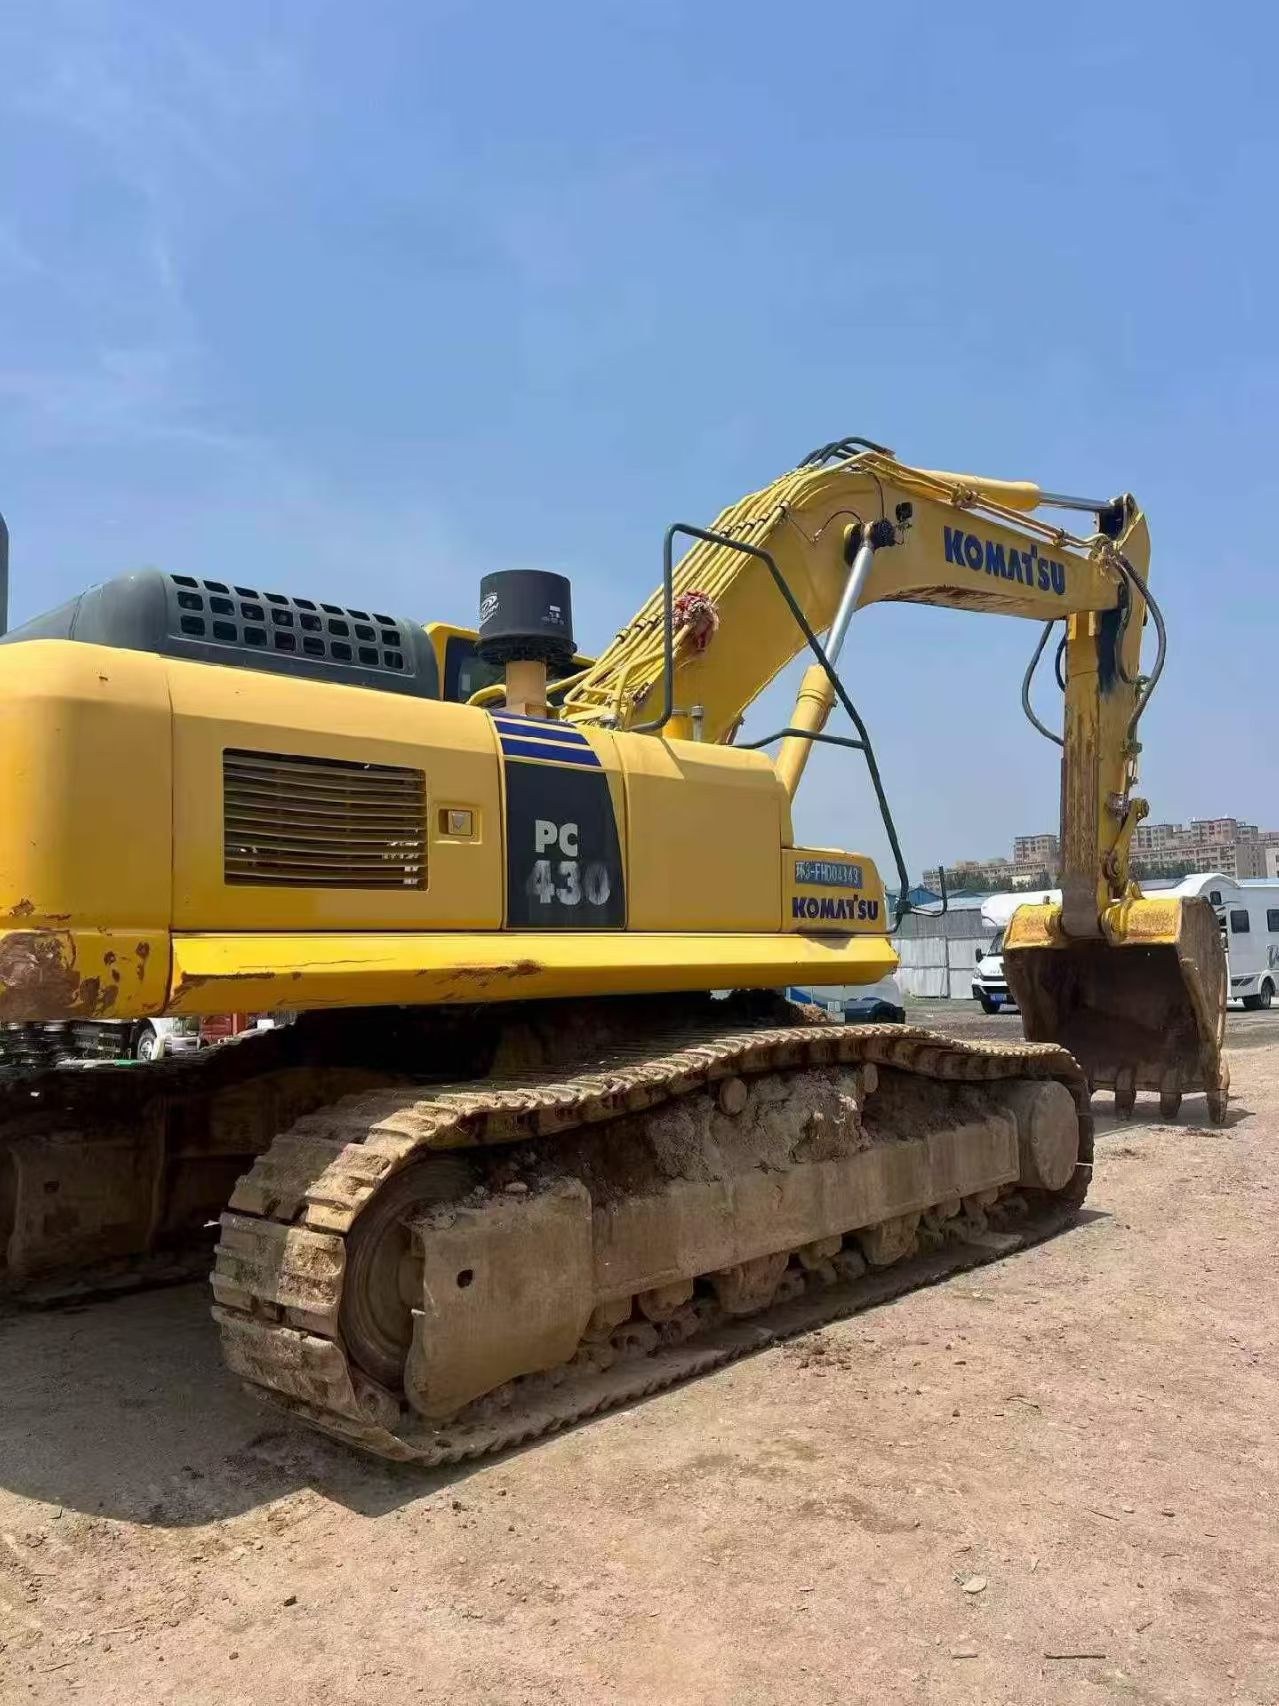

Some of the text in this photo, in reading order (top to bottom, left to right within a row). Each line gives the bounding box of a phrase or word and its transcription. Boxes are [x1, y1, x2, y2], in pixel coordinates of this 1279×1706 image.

[943, 525, 1066, 595] KOMATSU
[535, 819, 578, 857] PC
[526, 860, 610, 906] 430
[792, 894, 878, 920] KOMATSU
